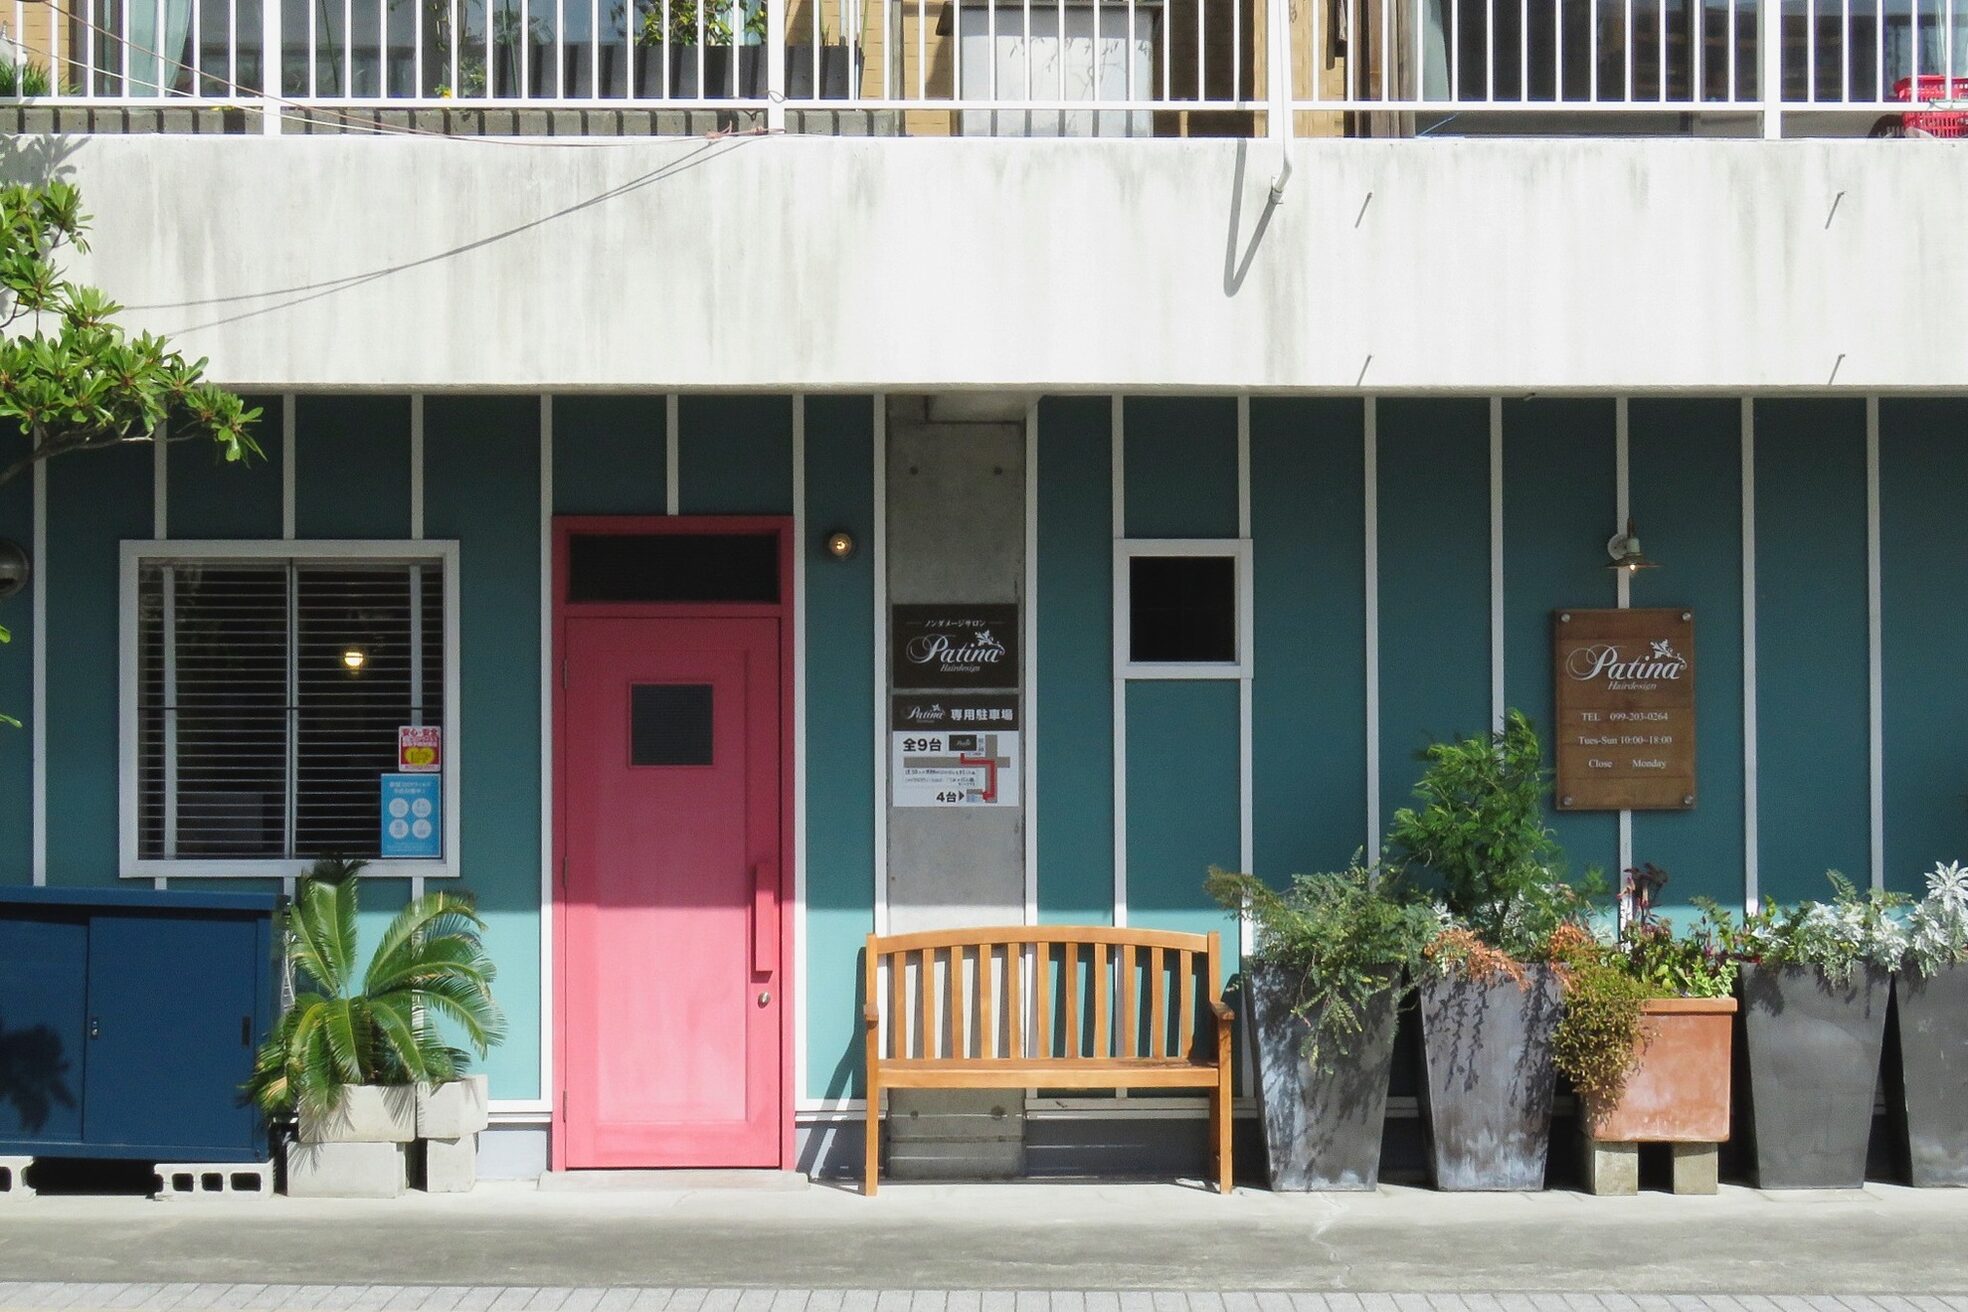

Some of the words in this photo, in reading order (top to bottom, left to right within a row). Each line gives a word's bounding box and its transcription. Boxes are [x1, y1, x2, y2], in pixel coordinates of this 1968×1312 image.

[925, 619, 986, 628] ノンダメージサロン
[906, 633, 1004, 664] Patina
[1566, 643, 1683, 680] Patina
[1608, 681, 1657, 690] Hairdesign
[905, 705, 945, 720] Patina
[950, 708, 1013, 721] 専用駐車場
[1582, 712, 1600, 721] TEL
[903, 738, 942, 752] 全9台
[1579, 736, 1618, 745] Tues-Sun
[1588, 759, 1613, 768] Close
[1632, 759, 1666, 769] Monday
[936, 792, 957, 803] 4台
